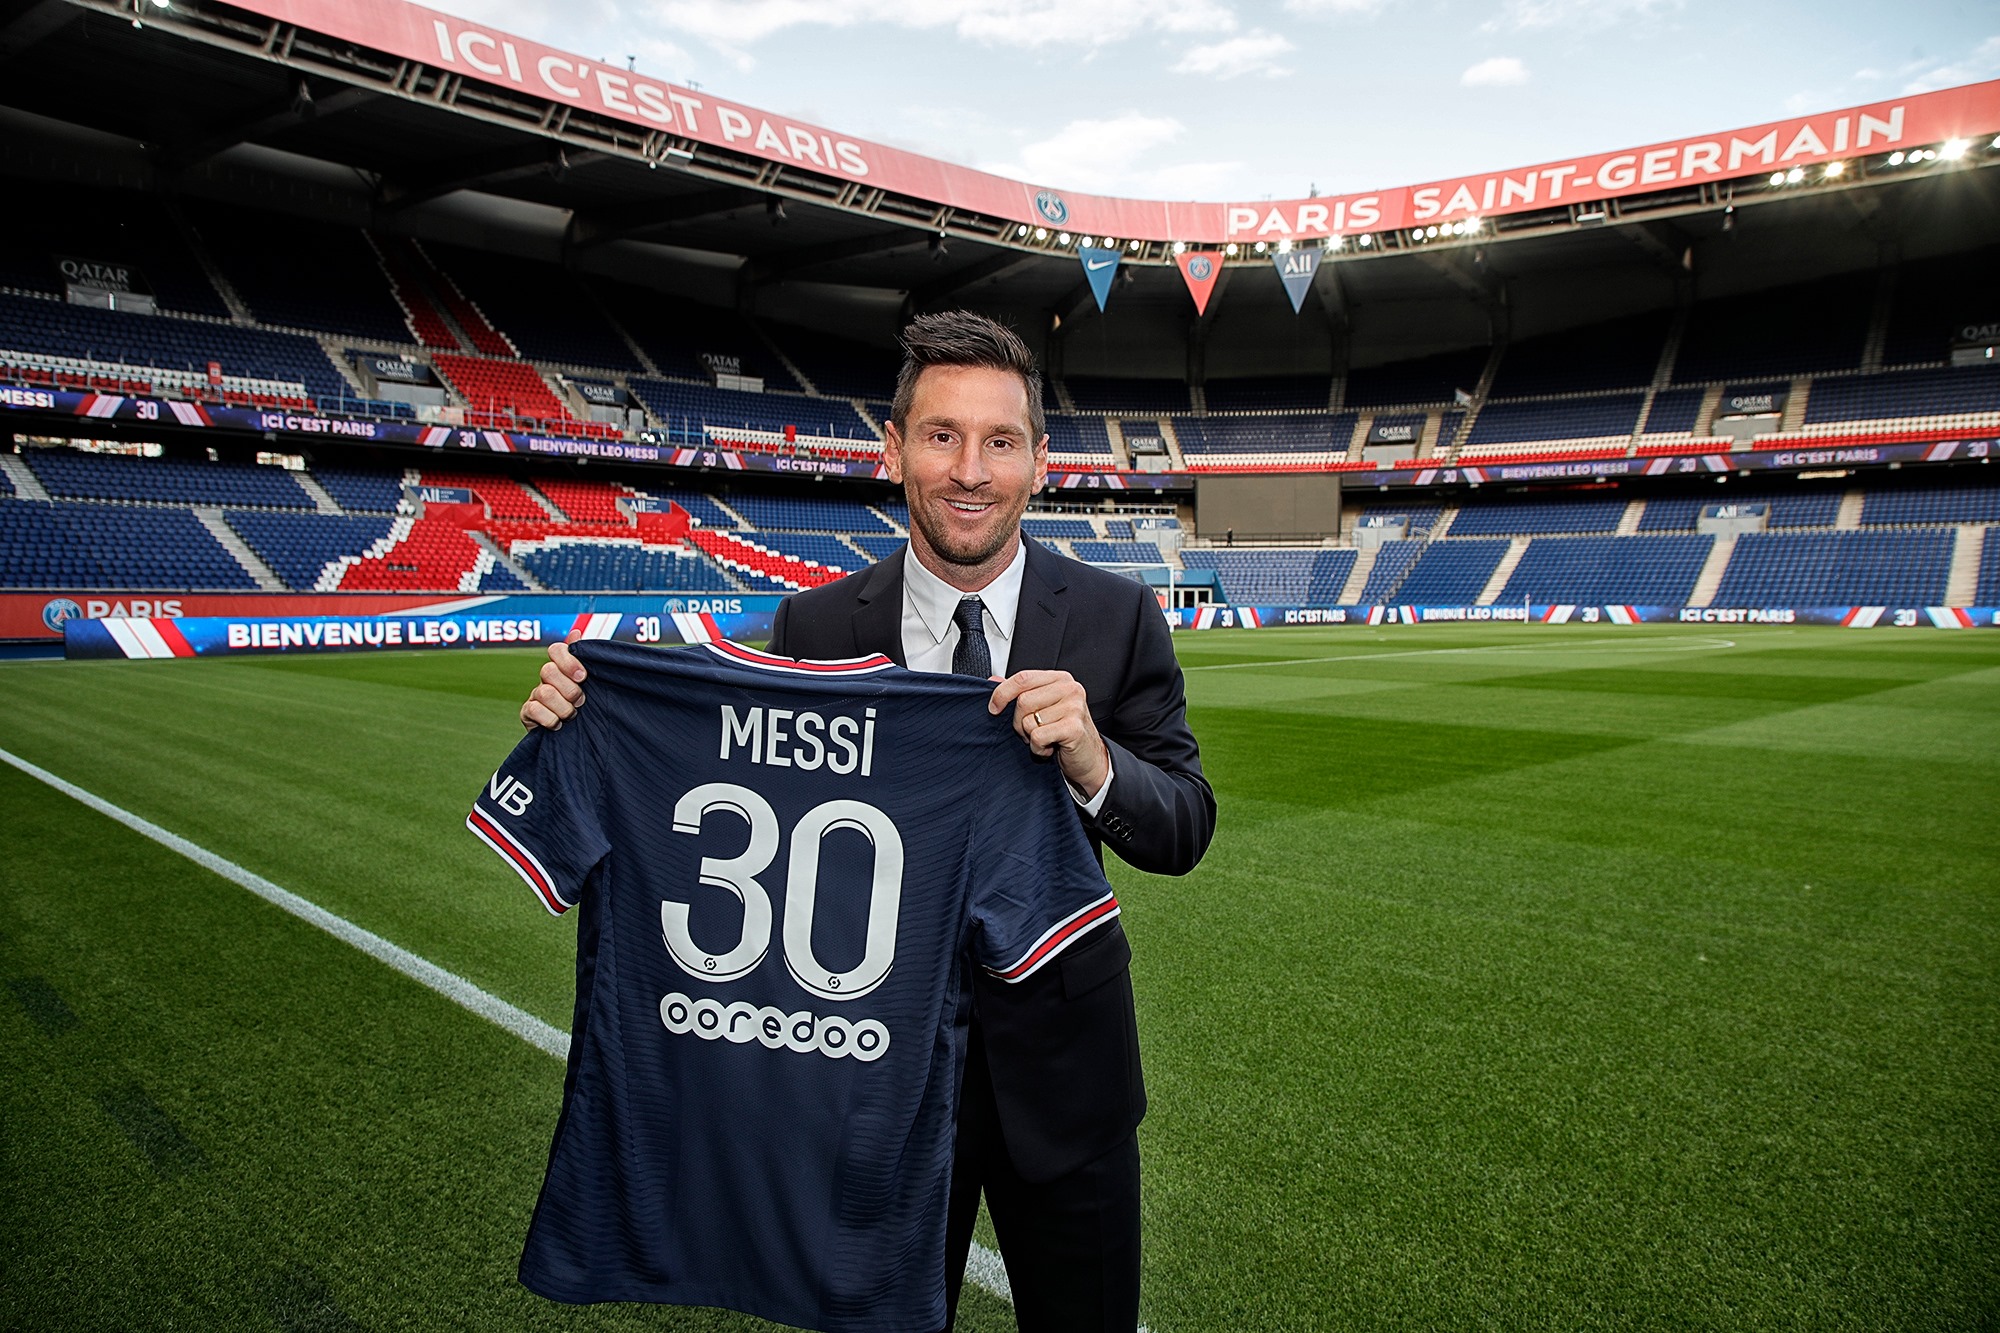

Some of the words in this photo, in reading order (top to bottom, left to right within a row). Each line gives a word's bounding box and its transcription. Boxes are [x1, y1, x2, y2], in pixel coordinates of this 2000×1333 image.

[433, 19, 523, 84] ICI
[537, 54, 704, 132] C'EST
[715, 105, 870, 178] PARIS
[1228, 196, 1381, 236] PARIS
[1413, 106, 1906, 220] SAINT-GERMAIN
[60, 260, 129, 283] QATAR
[1961, 323, 2000, 341] QAT
[376, 359, 414, 375] QATAR
[584, 384, 615, 399] QATAR
[136, 400, 159, 420] 30
[261, 413, 284, 429] ICI
[286, 415, 331, 433] C'EST
[332, 419, 376, 437] PARIS
[459, 431, 476, 448] 30
[529, 438, 599, 455] BIENVENUE
[600, 443, 623, 457] LEO
[625, 446, 659, 461] MESSI
[1773, 453, 1793, 466] ICI
[1794, 450, 1835, 465] C'EST
[1836, 448, 1878, 463] PARIS
[1966, 441, 1989, 458] 30
[703, 451, 717, 467] 30
[776, 458, 790, 471] ICI
[792, 460, 818, 473] C'EST
[819, 461, 847, 475] PARIS
[1679, 457, 1697, 473] 30
[1442, 469, 1458, 484] 30
[1501, 465, 1566, 479] BIENVENUE
[1567, 463, 1591, 476] LEO
[1592, 461, 1629, 475] MESSI
[1087, 475, 1100, 489] 30
[87, 600, 184, 619] PARIS
[687, 599, 743, 614] PARIS
[1467, 607, 1491, 621] LEO
[1492, 607, 1526, 621] MESS
[1581, 606, 1599, 623] 30
[1221, 609, 1234, 628] 30
[1284, 609, 1298, 624] ICI
[1299, 609, 1322, 624] C'EST
[1322, 608, 1346, 623] PARIS
[1679, 608, 1701, 623] ICI
[1701, 608, 1745, 623] C'EST
[1747, 608, 1796, 624] PARIS
[1893, 608, 1918, 627] 30
[227, 621, 402, 648] BIENVENUE
[408, 620, 460, 644] LEO
[466, 619, 541, 642] MESSI
[635, 616, 661, 643] 30
[660, 783, 905, 1000] 30
[666, 1000, 883, 1054] ooredoo
